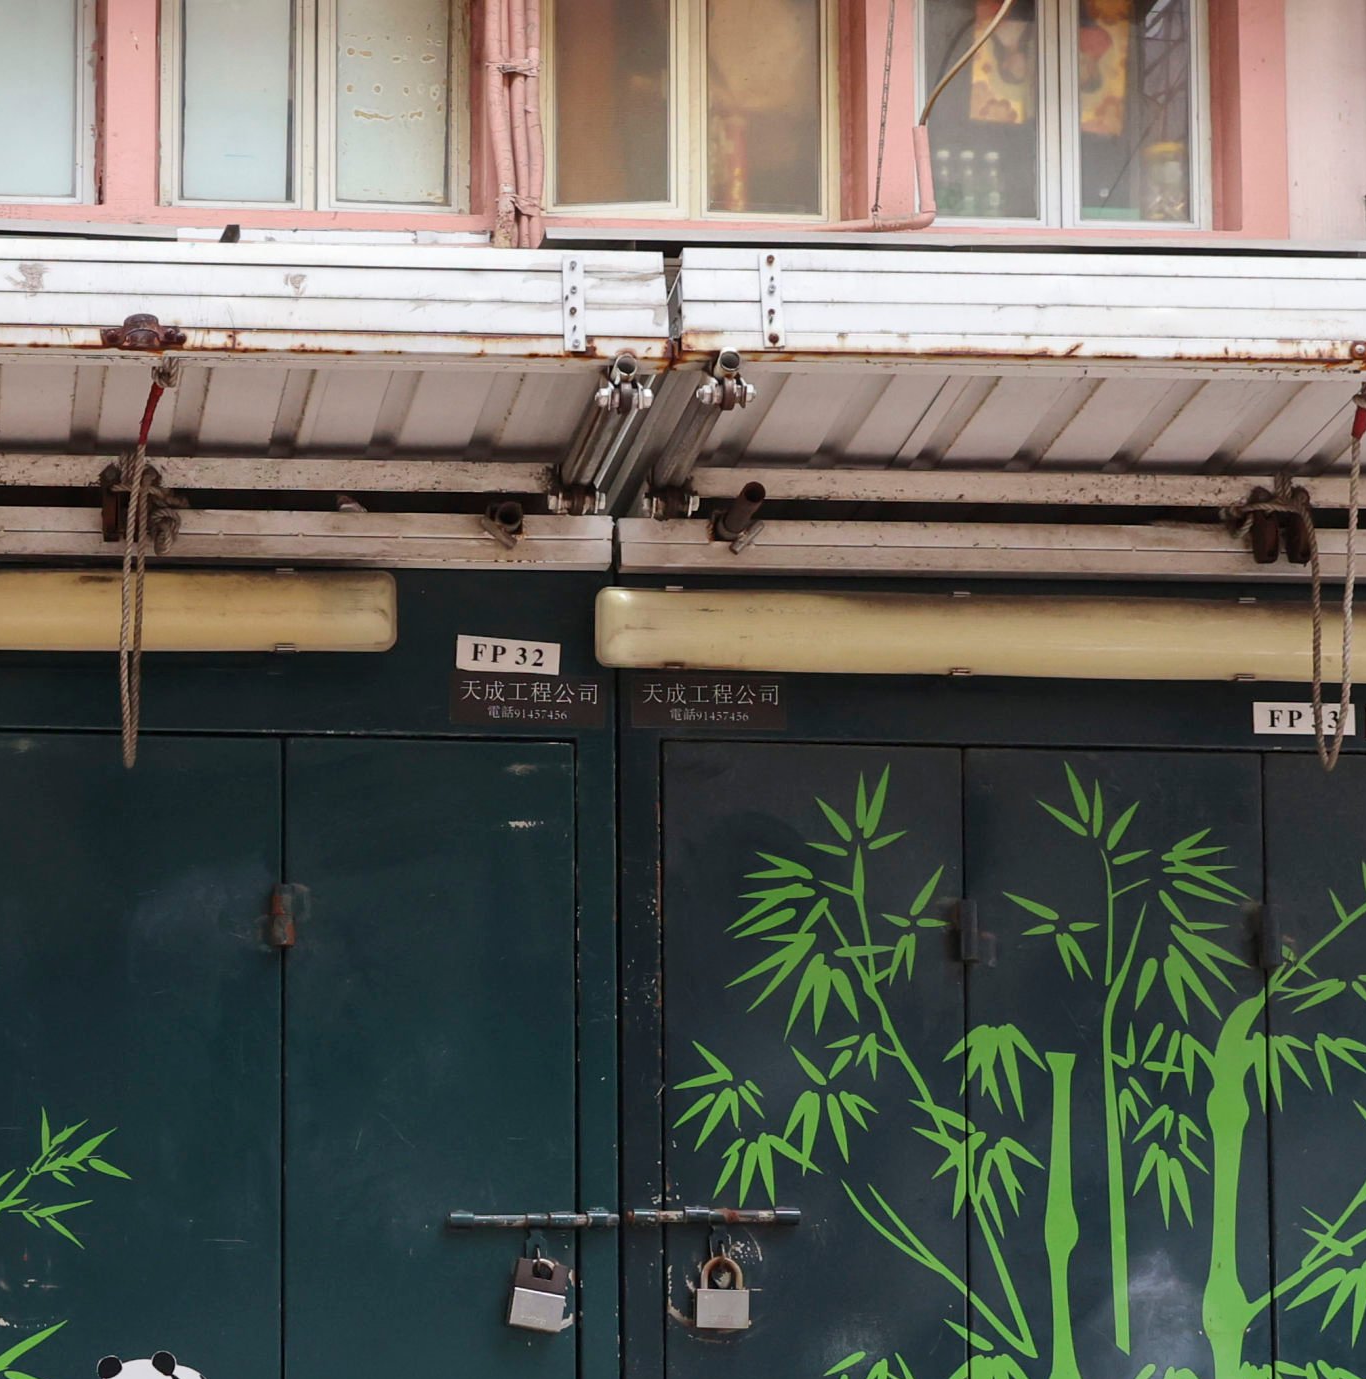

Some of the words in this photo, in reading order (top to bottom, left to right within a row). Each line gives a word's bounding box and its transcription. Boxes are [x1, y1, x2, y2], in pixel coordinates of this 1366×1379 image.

[470, 642, 507, 663] FP
[514, 647, 545, 667] 32
[459, 680, 599, 705] 天成工程公司
[642, 683, 780, 706] 天成工程公司
[1268, 709, 1302, 729] FP
